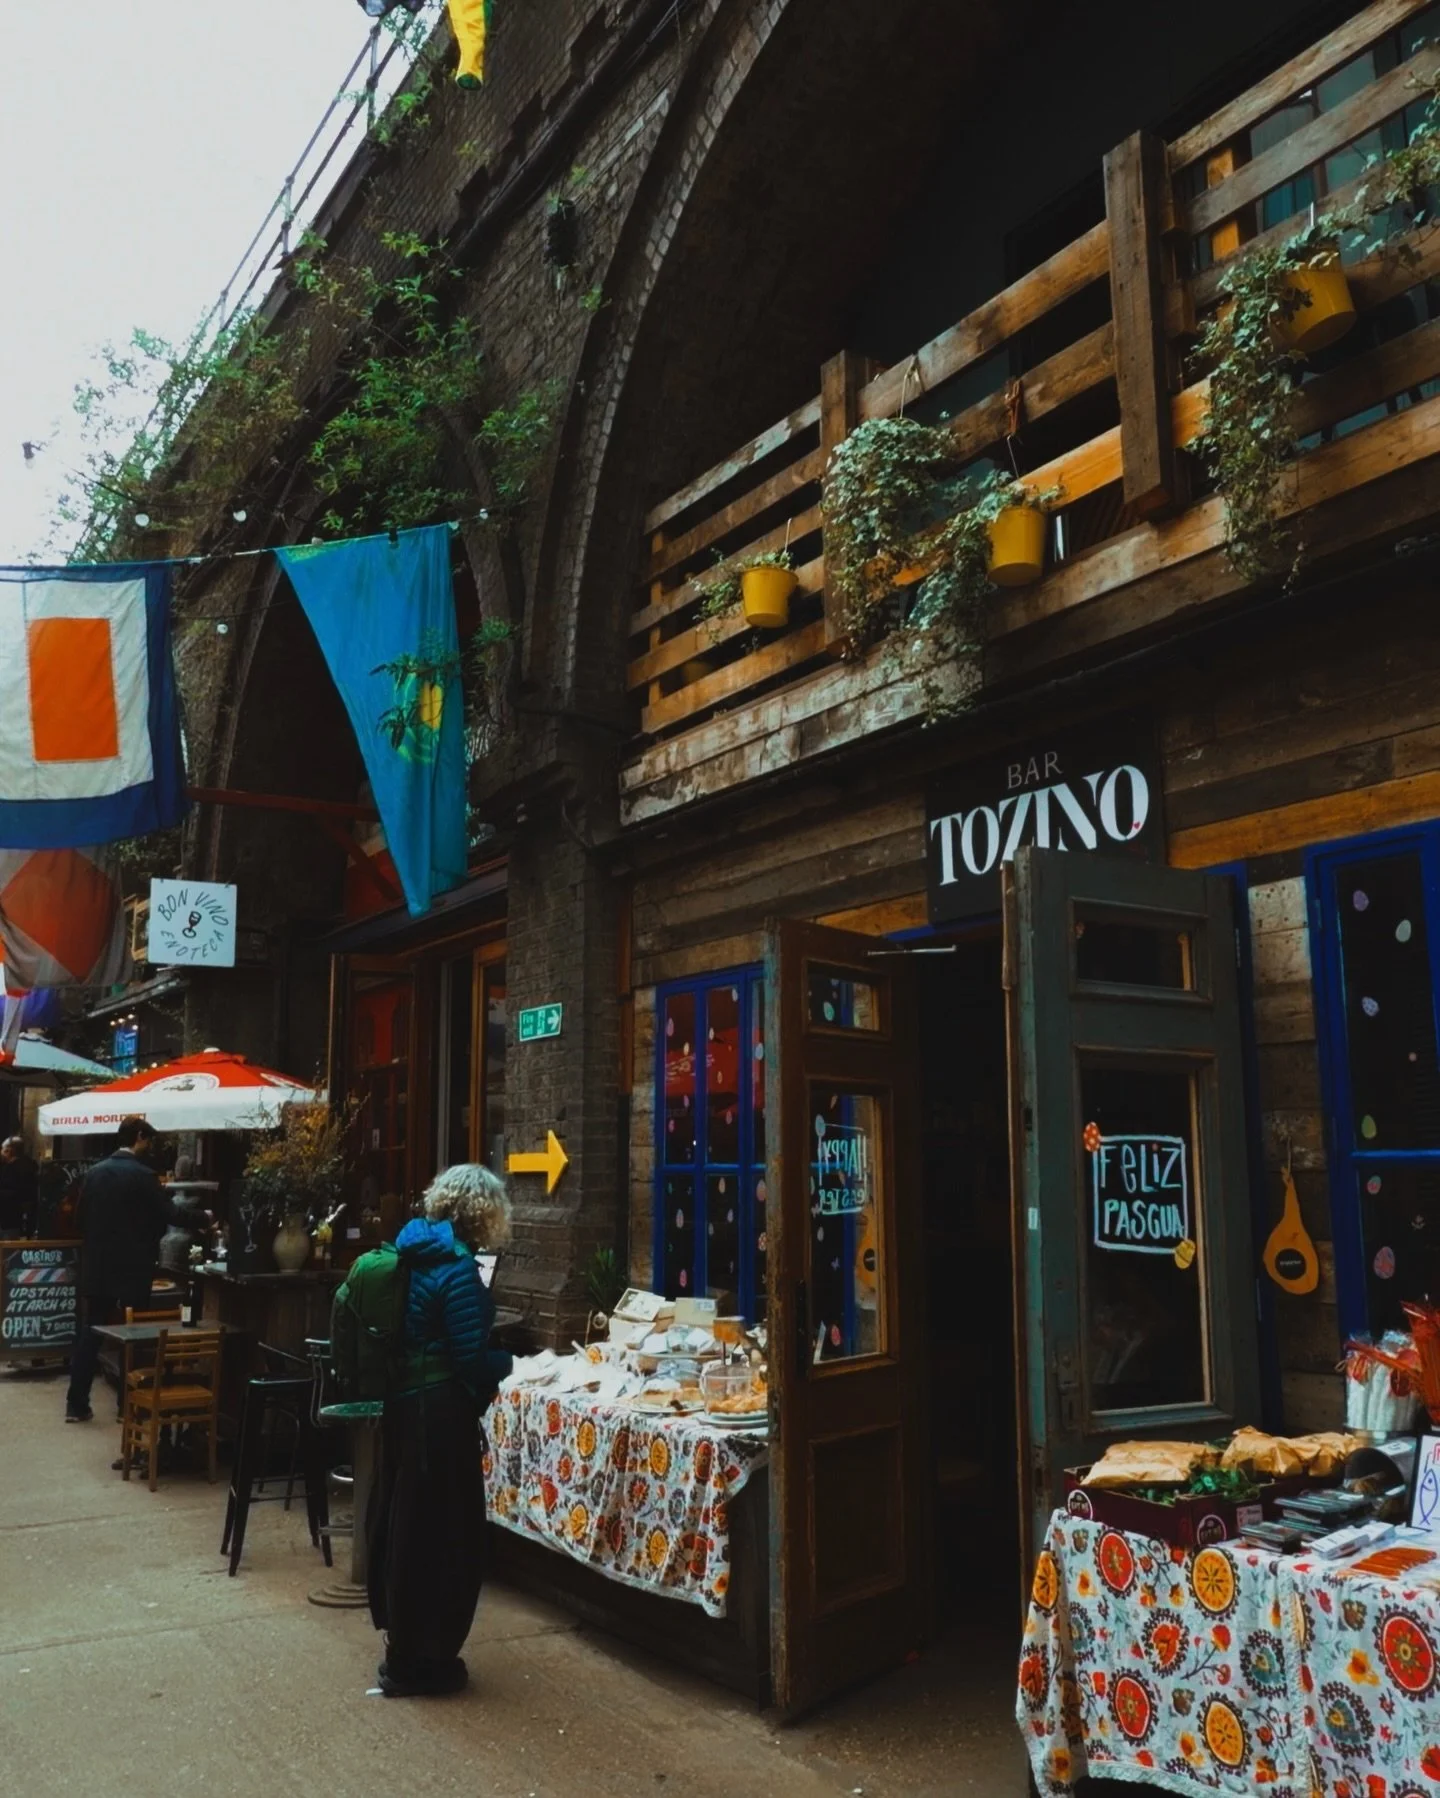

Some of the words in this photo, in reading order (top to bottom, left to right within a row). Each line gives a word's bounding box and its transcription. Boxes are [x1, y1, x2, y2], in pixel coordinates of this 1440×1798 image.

[1007, 751, 1063, 789] BAR
[930, 764, 1149, 886] TOZINO
[157, 888, 189, 922] BON
[194, 891, 229, 926] VINO
[161, 930, 224, 960] ENOTECA
[53, 1117, 88, 1125] BIRRA
[6, 1300, 27, 1313] AT
[26, 1298, 59, 1312] ARCH
[60, 1298, 76, 1311] 49
[10, 1287, 76, 1298] UPSTAIRS
[2, 1315, 41, 1339] OPEN
[46, 1323, 52, 1331] 7
